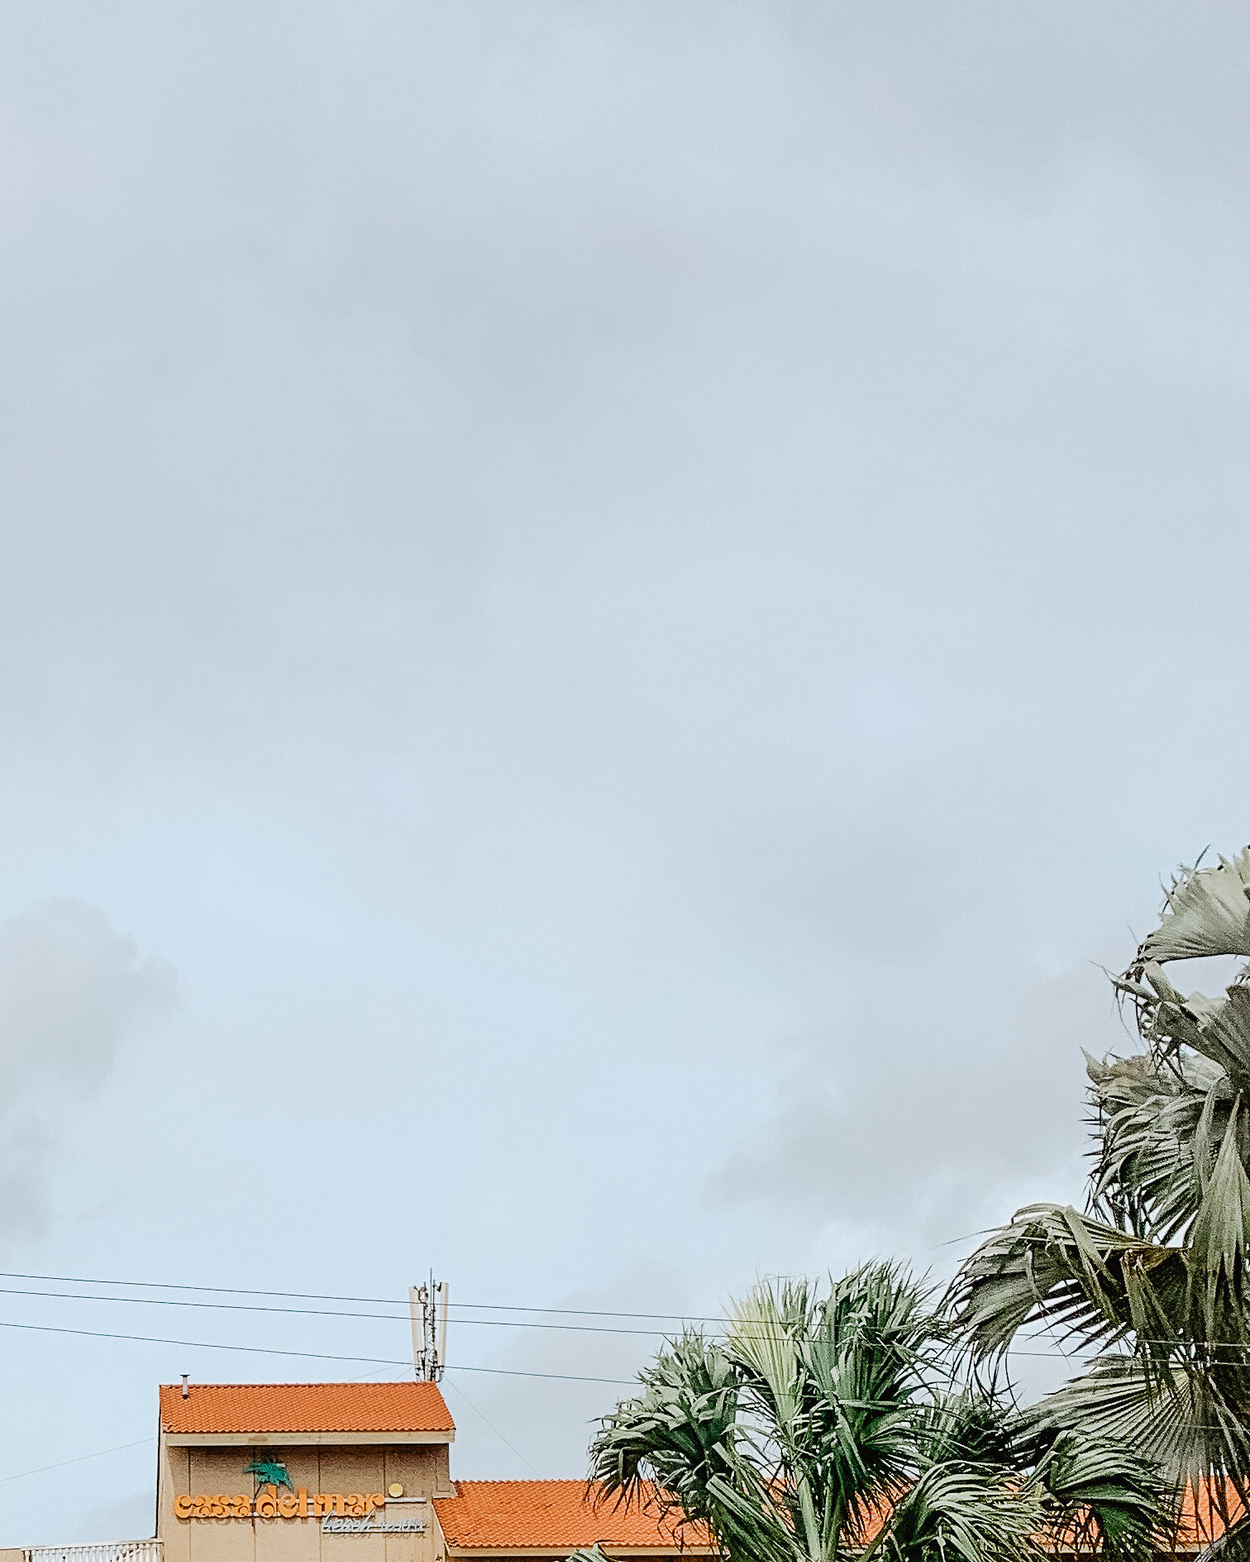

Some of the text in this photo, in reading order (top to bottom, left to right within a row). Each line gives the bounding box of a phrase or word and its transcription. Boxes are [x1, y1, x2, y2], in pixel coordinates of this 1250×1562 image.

[174, 1485, 385, 1519] casa del mar
